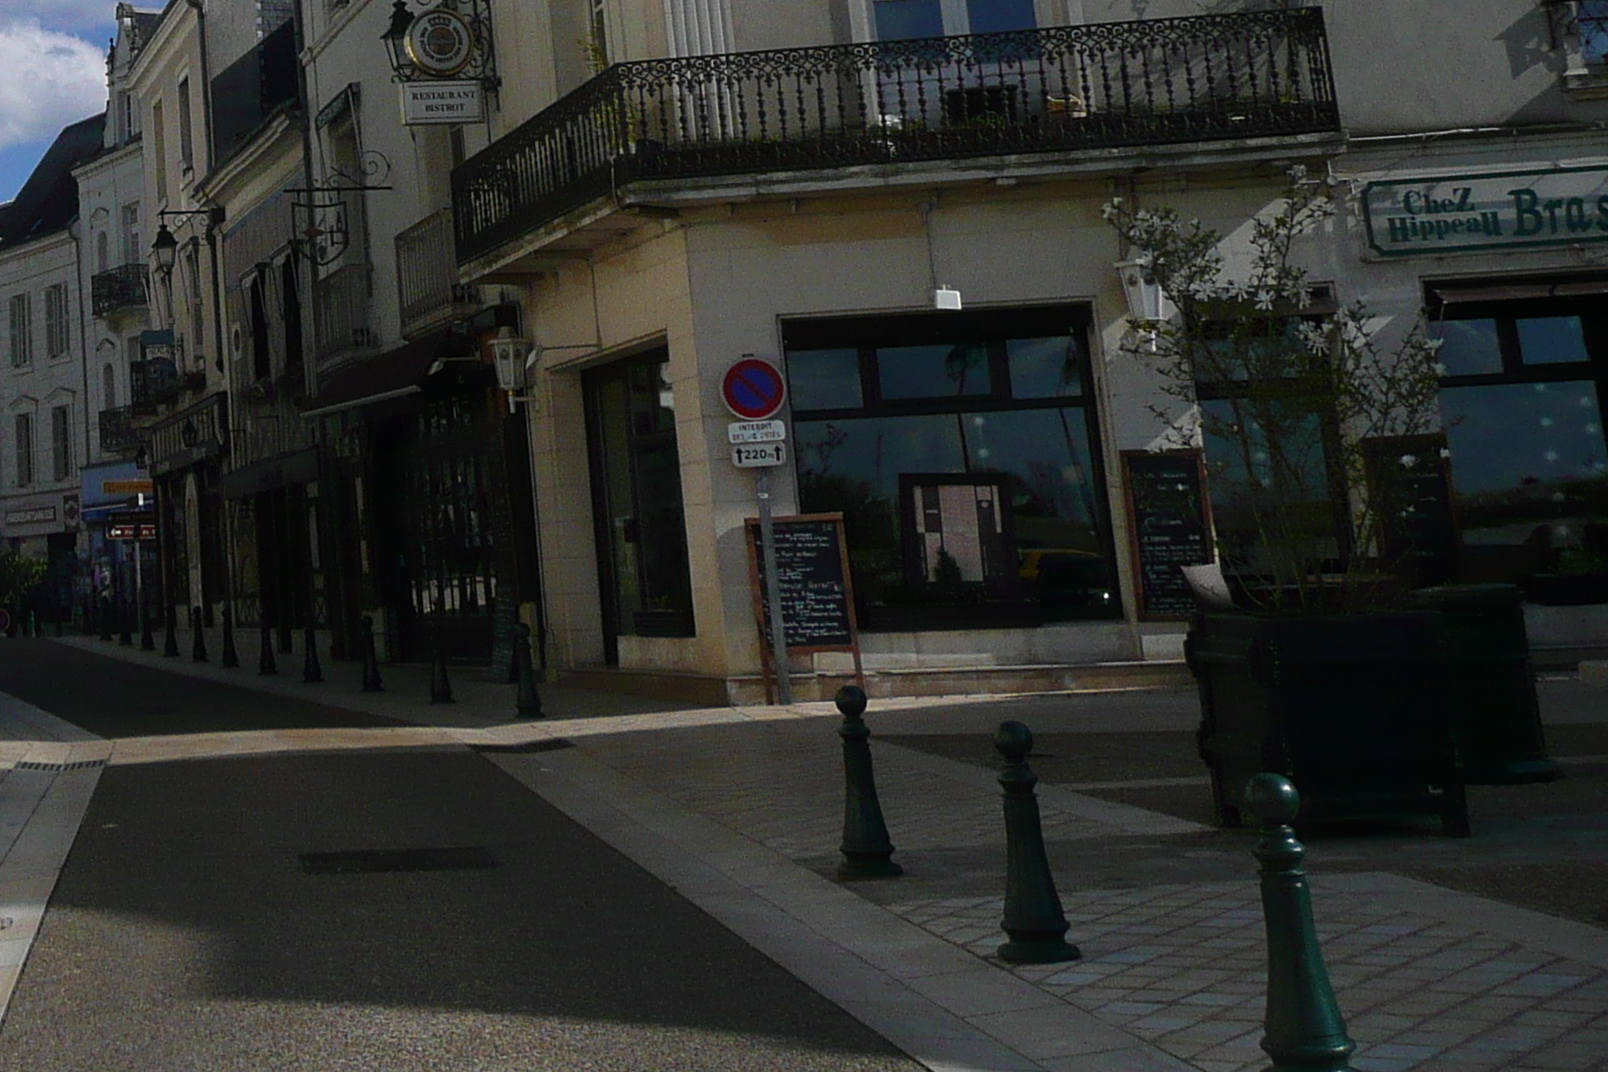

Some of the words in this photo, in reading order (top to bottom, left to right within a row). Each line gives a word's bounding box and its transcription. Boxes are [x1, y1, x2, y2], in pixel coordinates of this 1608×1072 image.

[412, 91, 475, 100] RESTAURANT
[425, 103, 465, 112] BISTROT
[739, 422, 772, 431] INTERDIT
